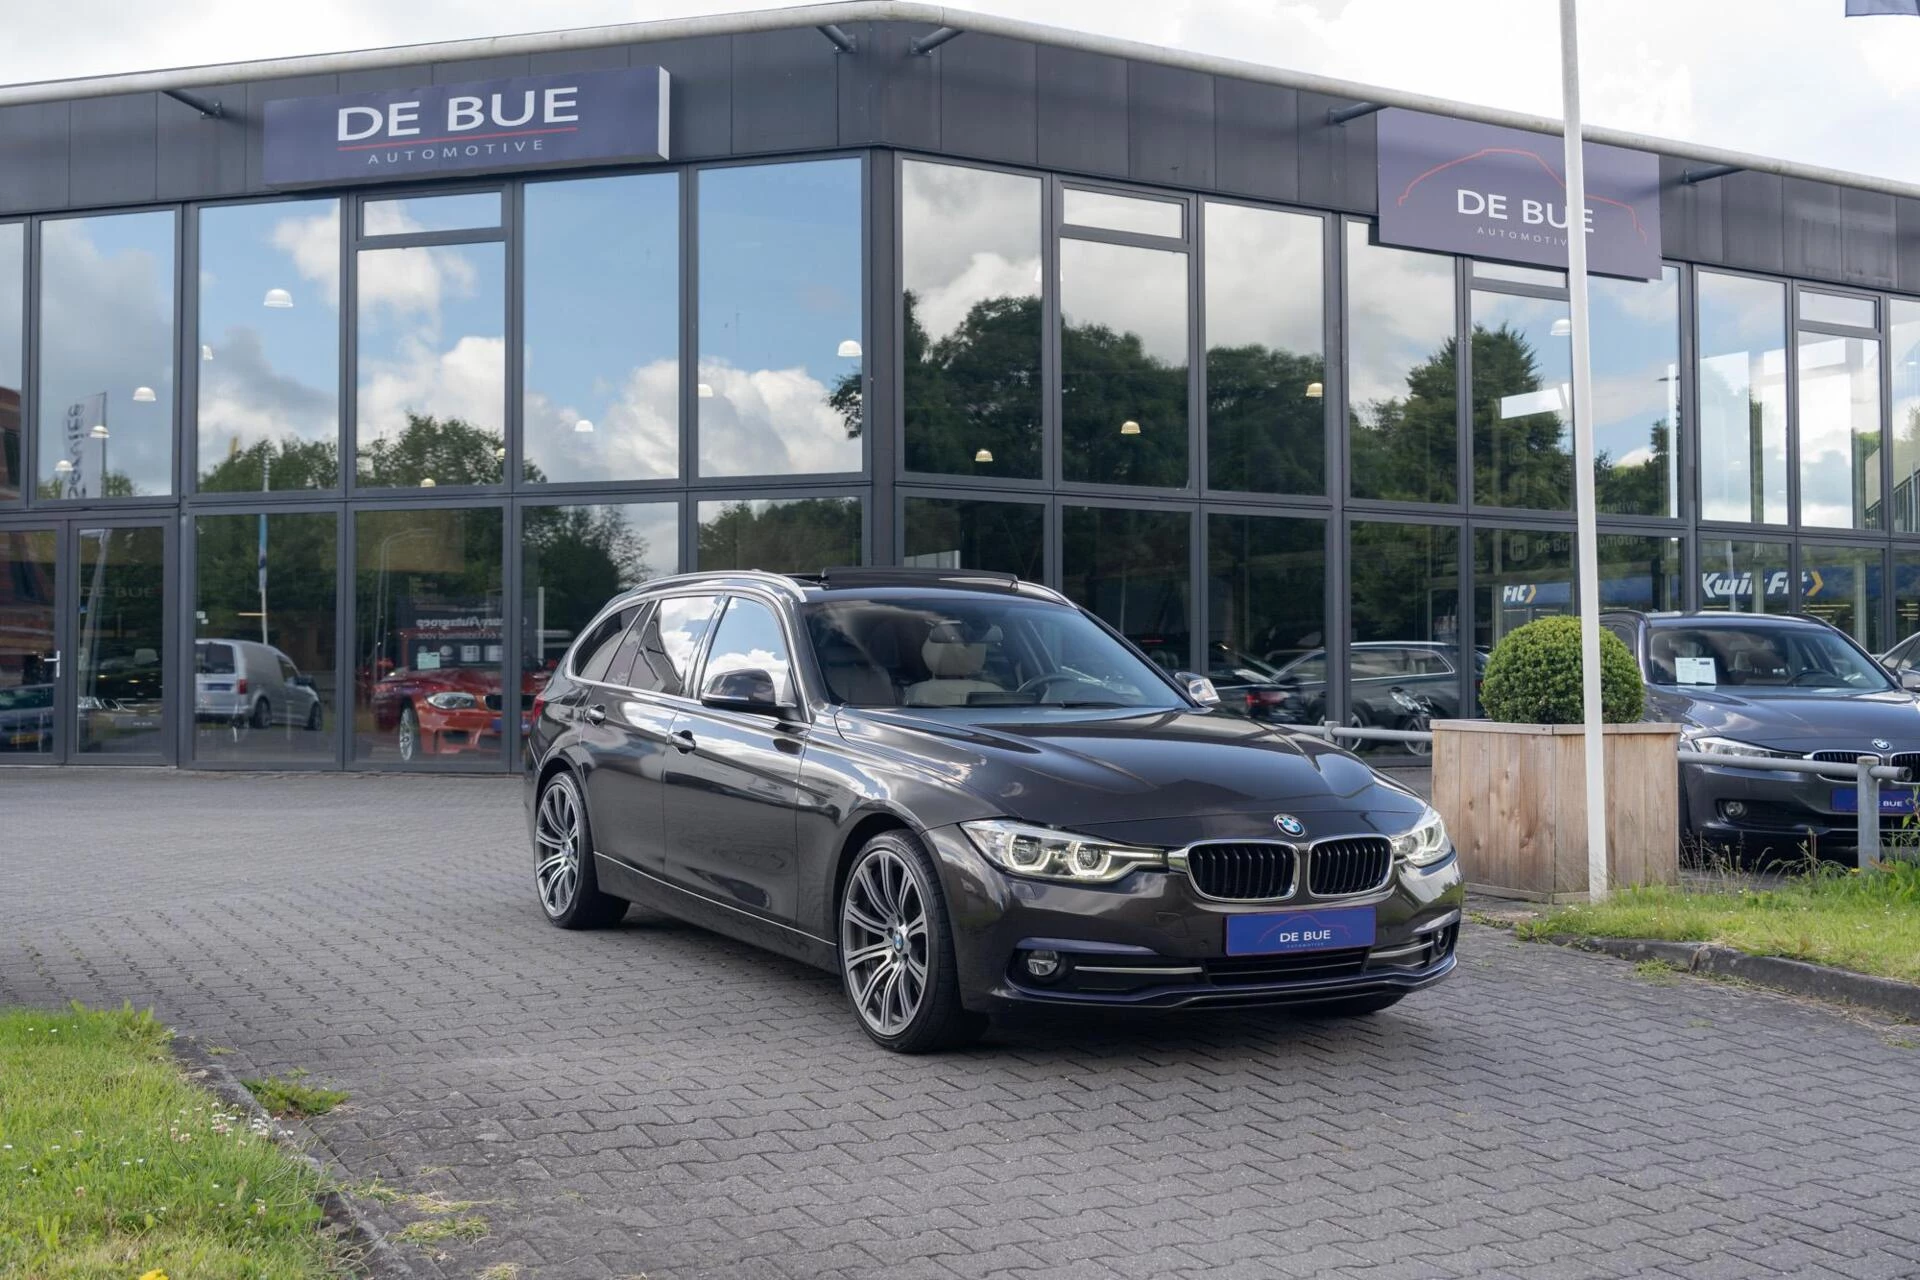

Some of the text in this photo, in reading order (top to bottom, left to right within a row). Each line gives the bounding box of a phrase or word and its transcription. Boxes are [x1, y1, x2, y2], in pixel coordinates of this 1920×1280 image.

[337, 86, 579, 142] DE BUE
[368, 139, 544, 165] AUTOMOTIVE
[1457, 189, 1508, 220] DE
[1477, 226, 1569, 247] AUTOMOTIV
[1279, 929, 1331, 943] DE BUE
